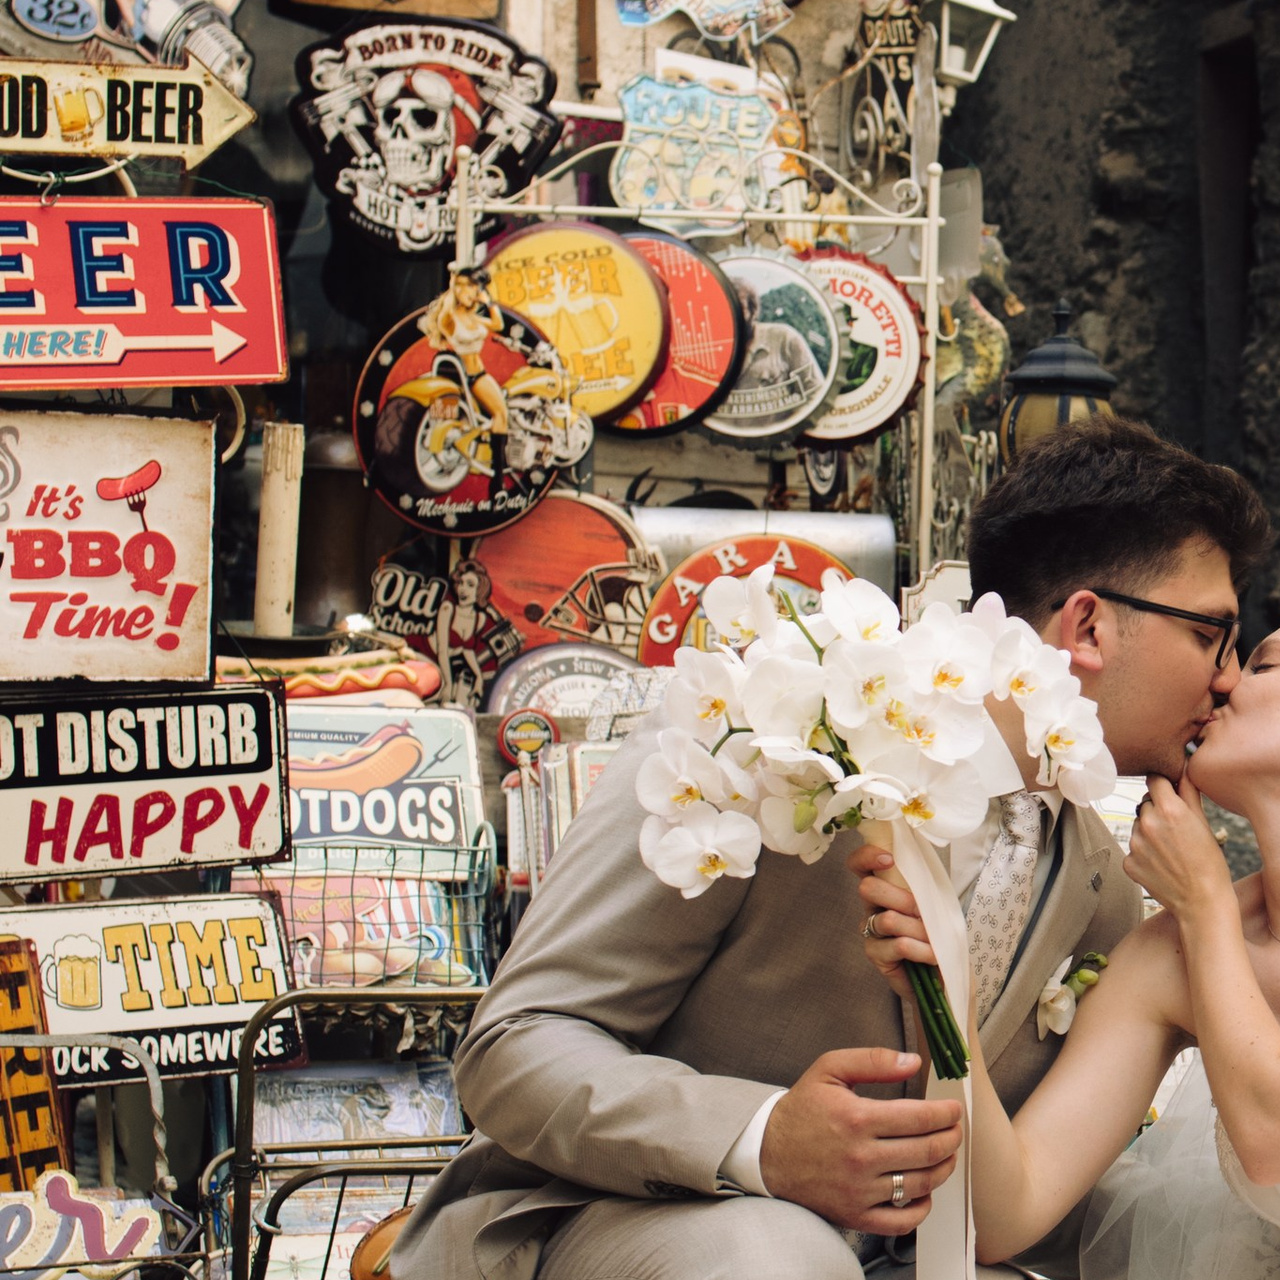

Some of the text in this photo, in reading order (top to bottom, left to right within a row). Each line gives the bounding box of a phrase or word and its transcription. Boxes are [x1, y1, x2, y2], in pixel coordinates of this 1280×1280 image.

[359, 32, 504, 70] BORN TO RIDE
[106, 79, 204, 145] BEER
[633, 90, 763, 139] ROUTE
[368, 194, 400, 223] HOT
[494, 245, 613, 272] ICE COLD
[493, 257, 622, 309] BEER
[3, 329, 106, 358] HERE!
[25, 484, 84, 520] It's
[416, 488, 537, 517] Mechanic on Duty!
[6, 529, 176, 596] BBQ
[9, 582, 199, 651] Time!
[376, 570, 441, 618] Old
[373, 606, 434, 636] School
[56, 703, 259, 775] DISTURB
[319, 731, 360, 743] QUALITY
[24, 783, 270, 866] HAPPY
[103, 917, 277, 1012] TIME
